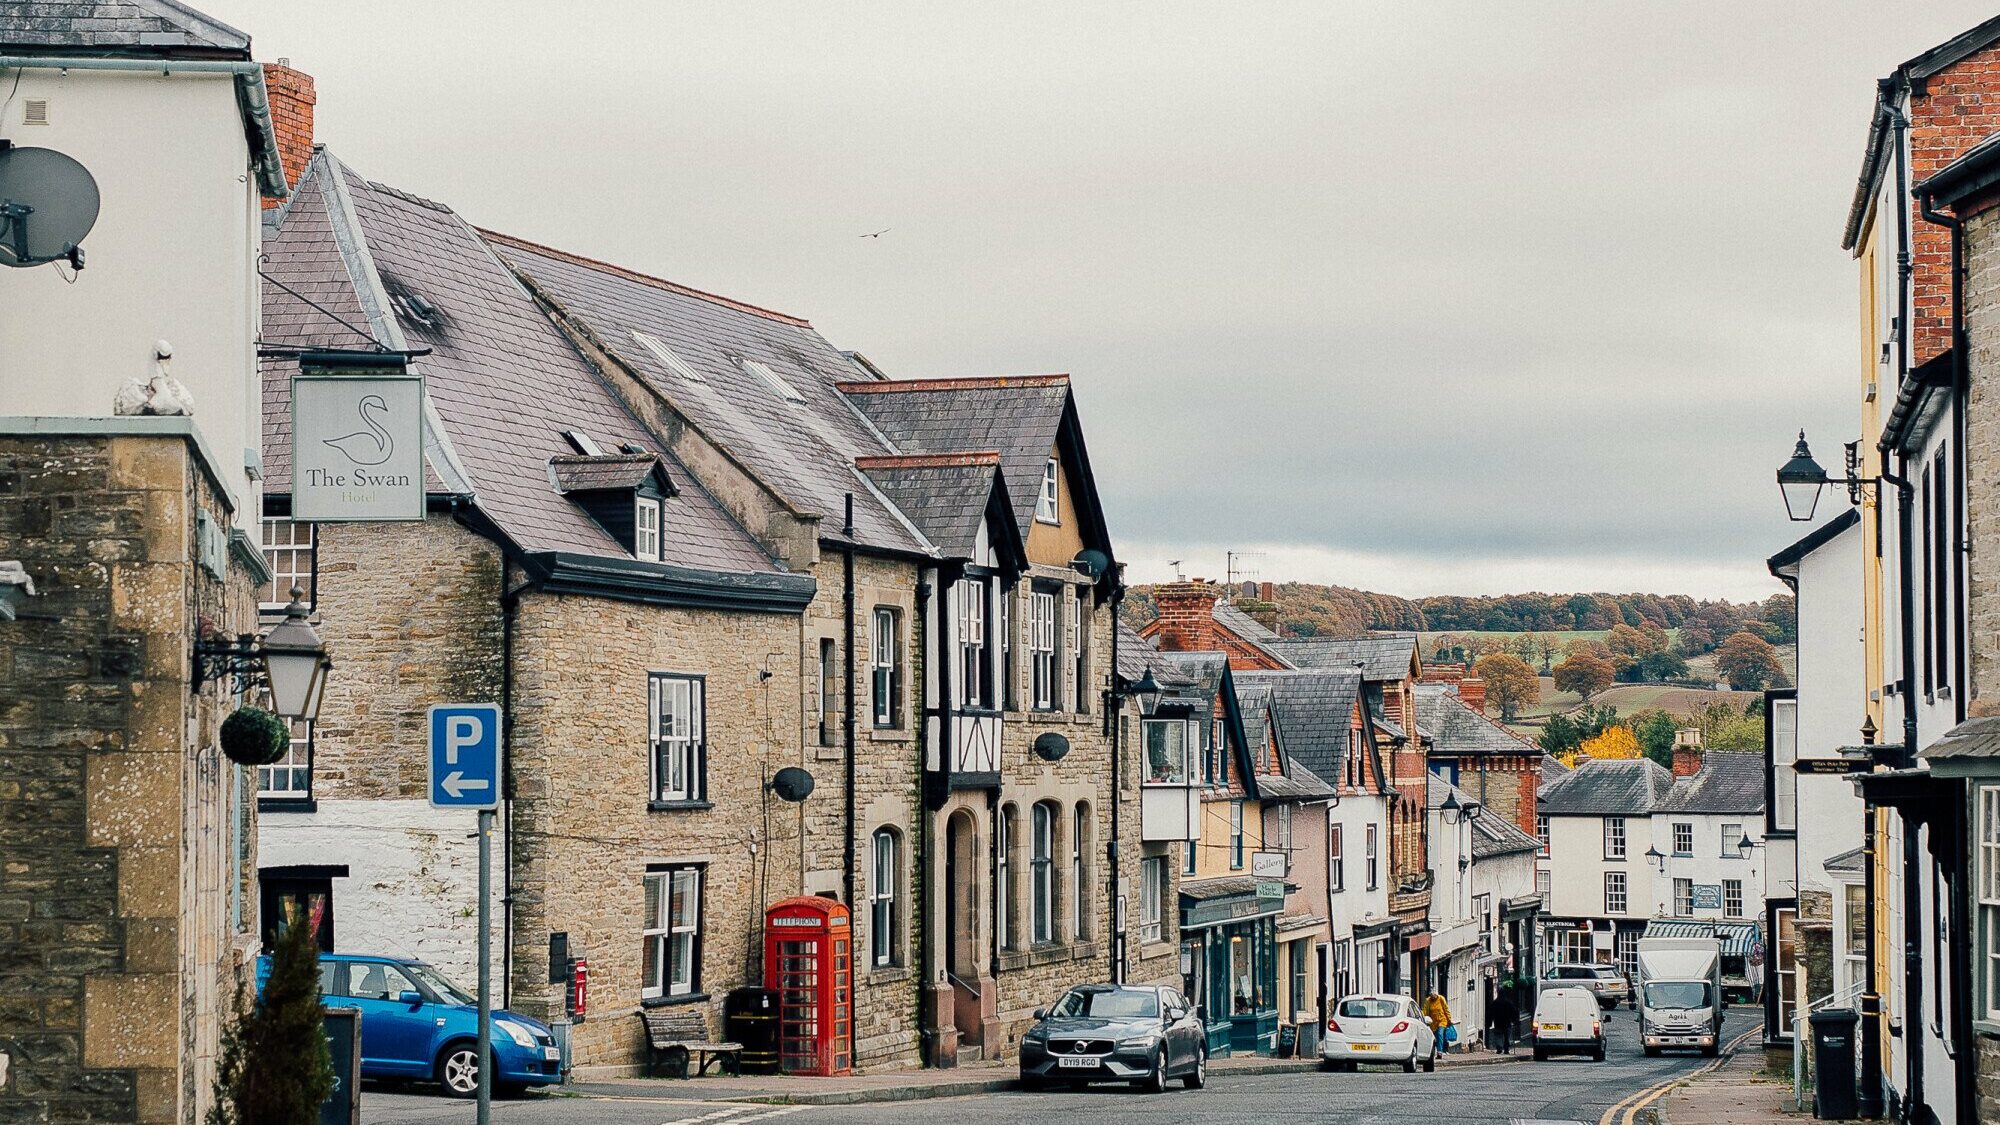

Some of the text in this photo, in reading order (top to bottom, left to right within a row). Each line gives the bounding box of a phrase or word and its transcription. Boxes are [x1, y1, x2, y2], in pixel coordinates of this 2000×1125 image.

[306, 468, 409, 486] The Swan
[342, 491, 376, 502] Hotel
[446, 715, 483, 764] P
[1254, 858, 1283, 871] Gallery
[1063, 1058, 1080, 1066] DY19
